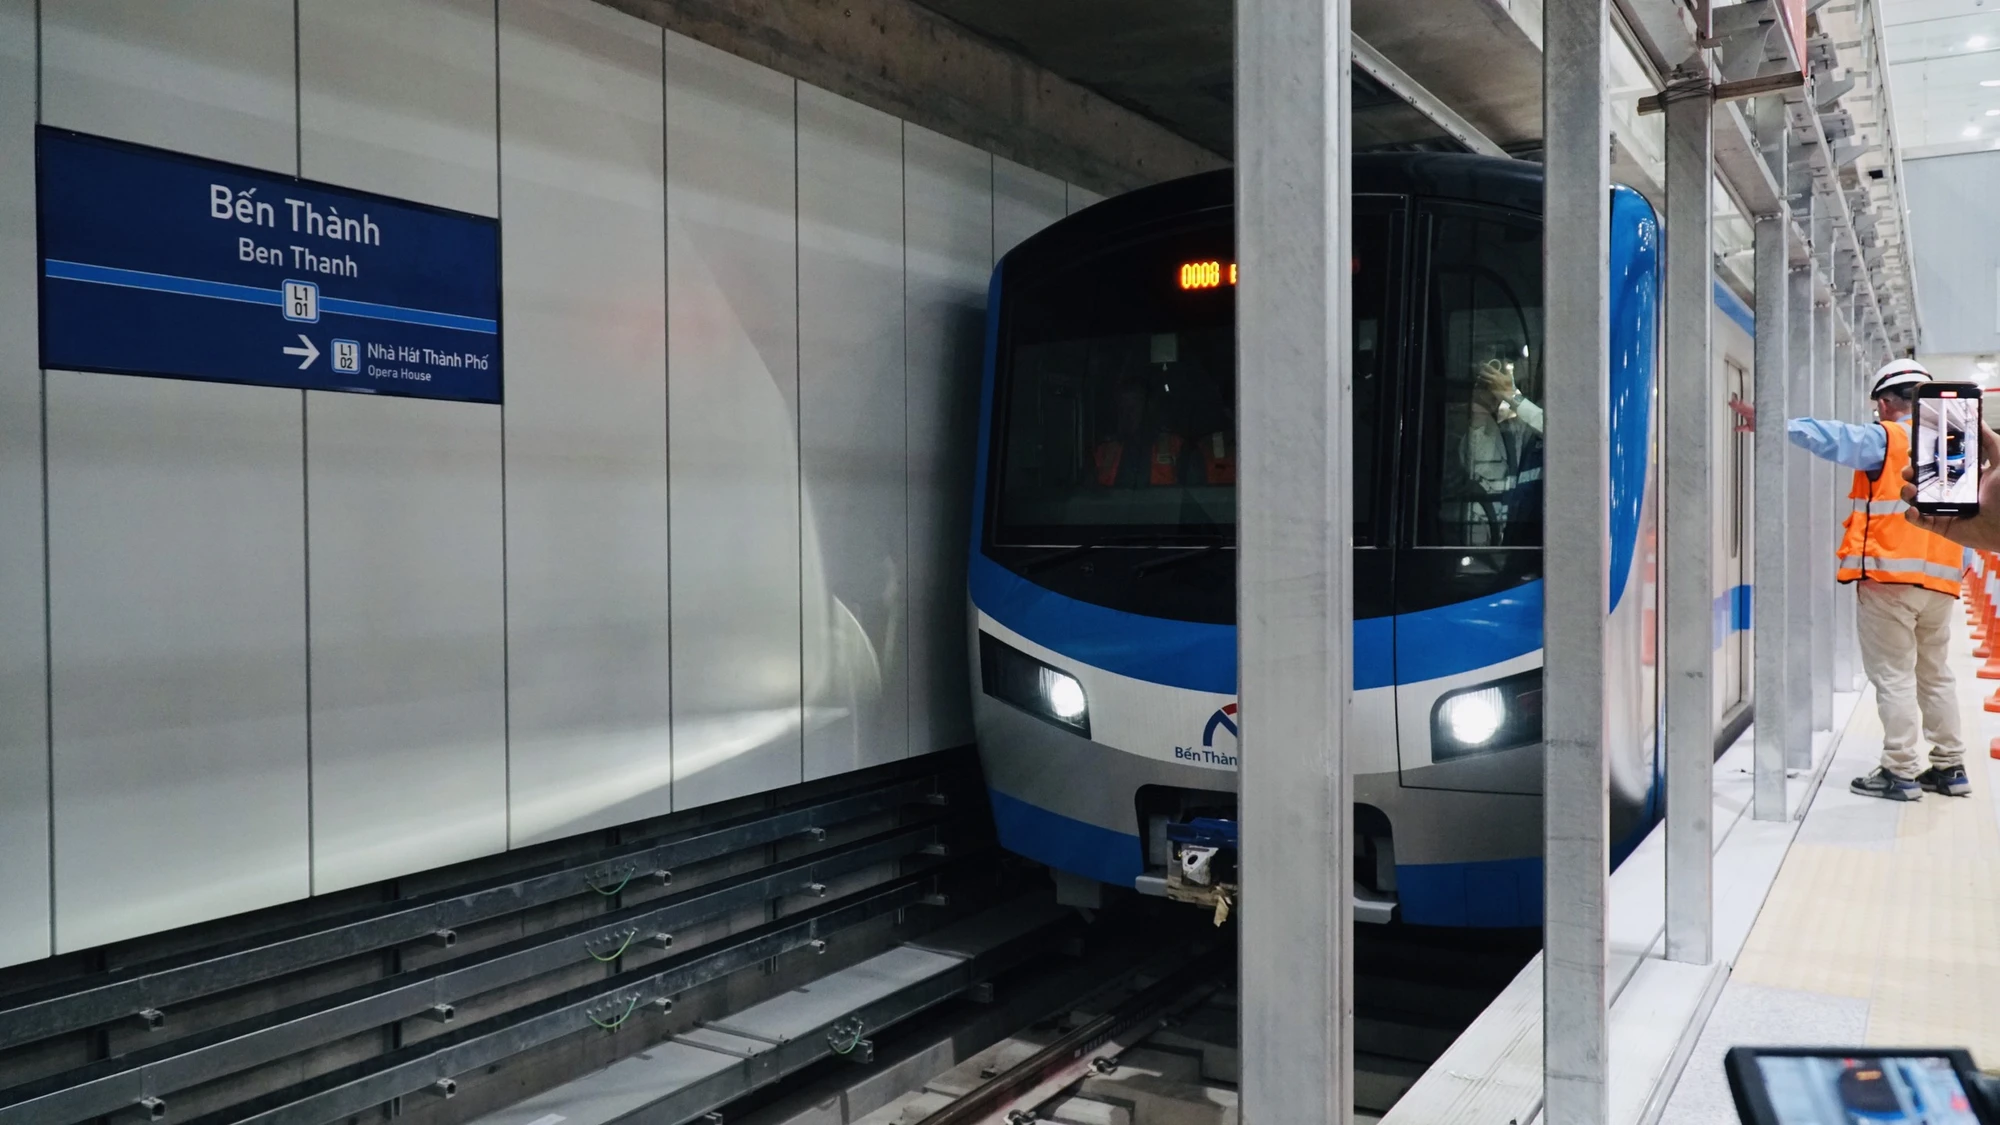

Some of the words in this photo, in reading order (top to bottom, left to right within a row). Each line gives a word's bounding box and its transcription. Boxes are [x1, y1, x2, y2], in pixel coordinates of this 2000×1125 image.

[210, 183, 275, 228] Bến
[284, 197, 381, 247] Thành
[238, 236, 284, 267] Ben
[289, 245, 359, 278] Thanh
[1181, 261, 1220, 289] 0008
[293, 285, 309, 301] L1
[294, 302, 308, 317] 01
[340, 343, 353, 357] L1
[367, 342, 396, 361] Nhà
[398, 346, 421, 364] Hát
[422, 348, 462, 368] Thành
[464, 353, 490, 371] Phố
[340, 356, 354, 370] 02
[367, 364, 399, 379] Opera
[400, 367, 432, 382] House
[1174, 746, 1201, 762] Bến
[1202, 750, 1238, 767] Thàn
